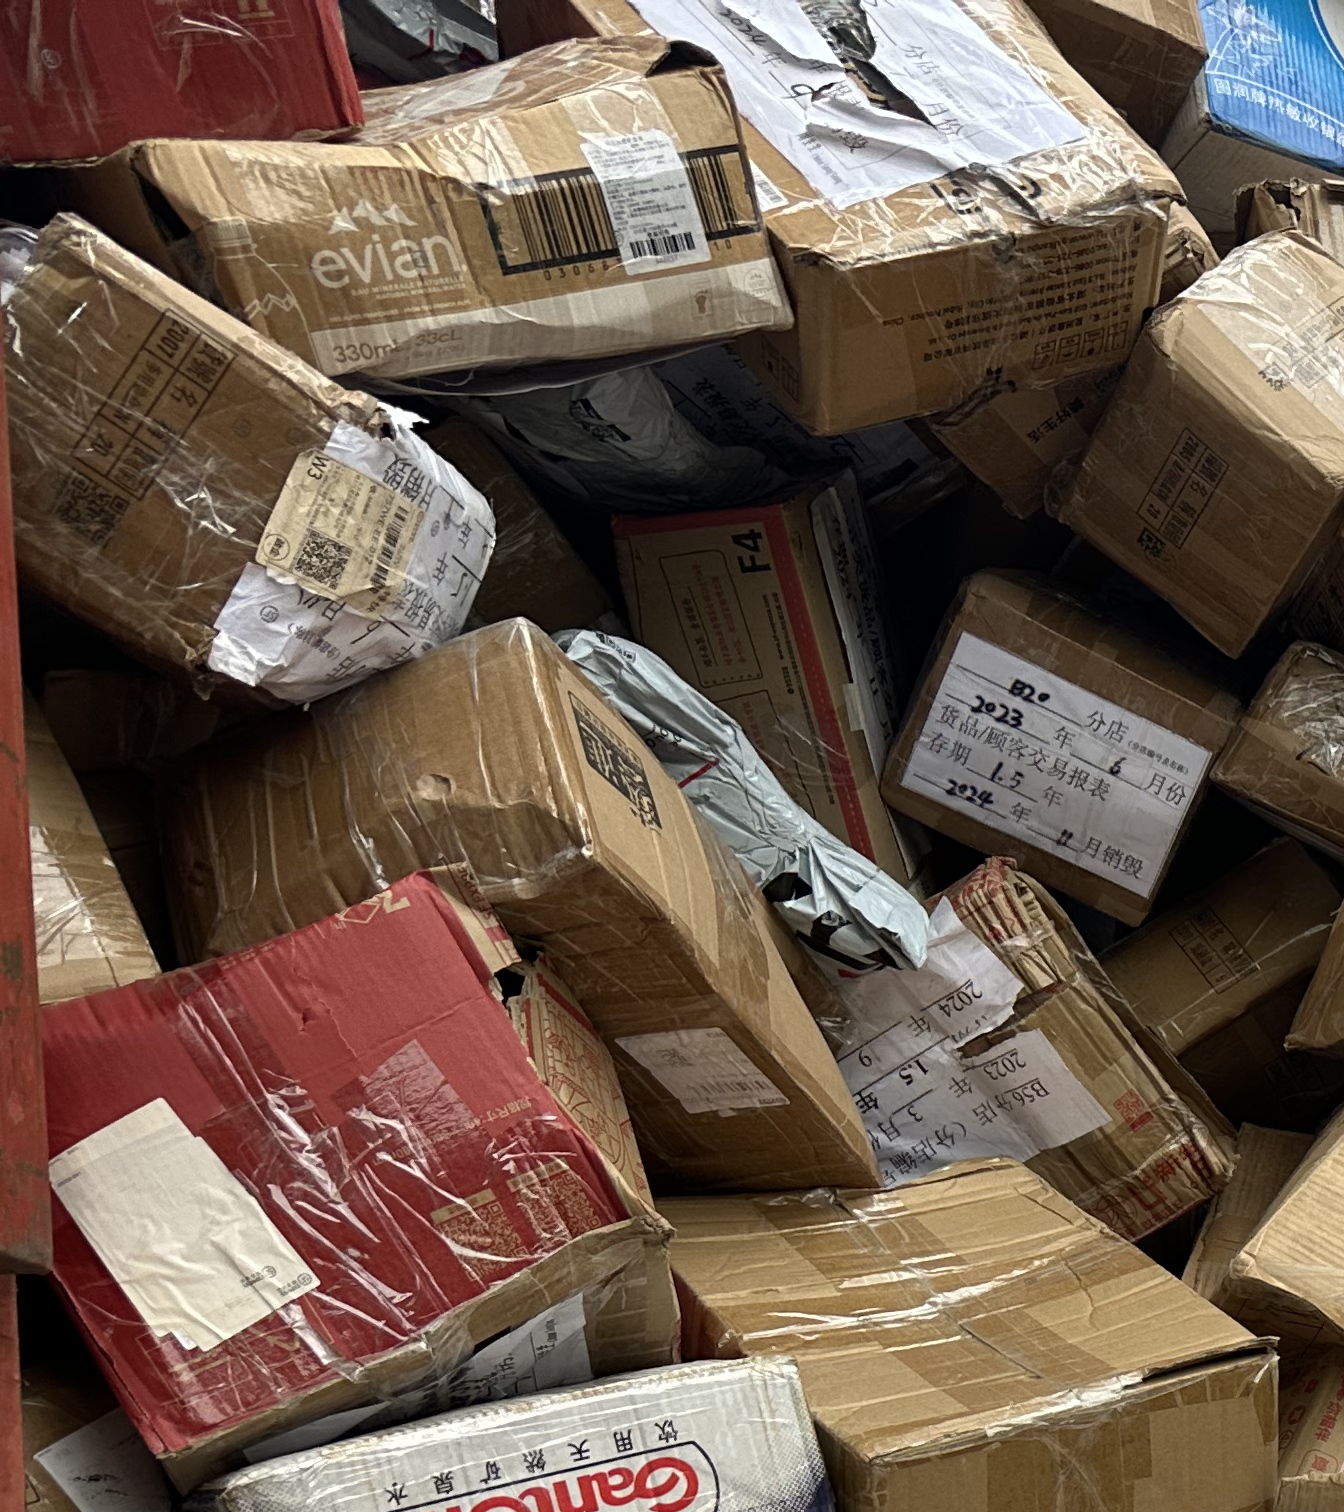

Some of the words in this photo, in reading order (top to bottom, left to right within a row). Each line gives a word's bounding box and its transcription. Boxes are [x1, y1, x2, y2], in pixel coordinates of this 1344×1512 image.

[158, 317, 192, 361] 2007
[306, 453, 331, 481] W3
[730, 528, 773, 575] F4
[1086, 709, 1130, 744] 分店
[936, 702, 1113, 803] 货品/顾客交易报表
[970, 694, 1026, 730] 2023
[1053, 725, 1077, 750] 年
[1143, 772, 1188, 807] 月份
[929, 732, 974, 767] 存期
[1041, 786, 1063, 809] 年
[1008, 802, 1032, 825] 年
[1083, 835, 1145, 881] 月销毁
[937, 979, 985, 1019] 2024
[908, 1015, 934, 1039] 年
[899, 1059, 930, 1088] 1.5
[982, 1047, 1029, 1082] 2023
[857, 1090, 880, 1115] 年
[948, 1075, 974, 1099] 年
